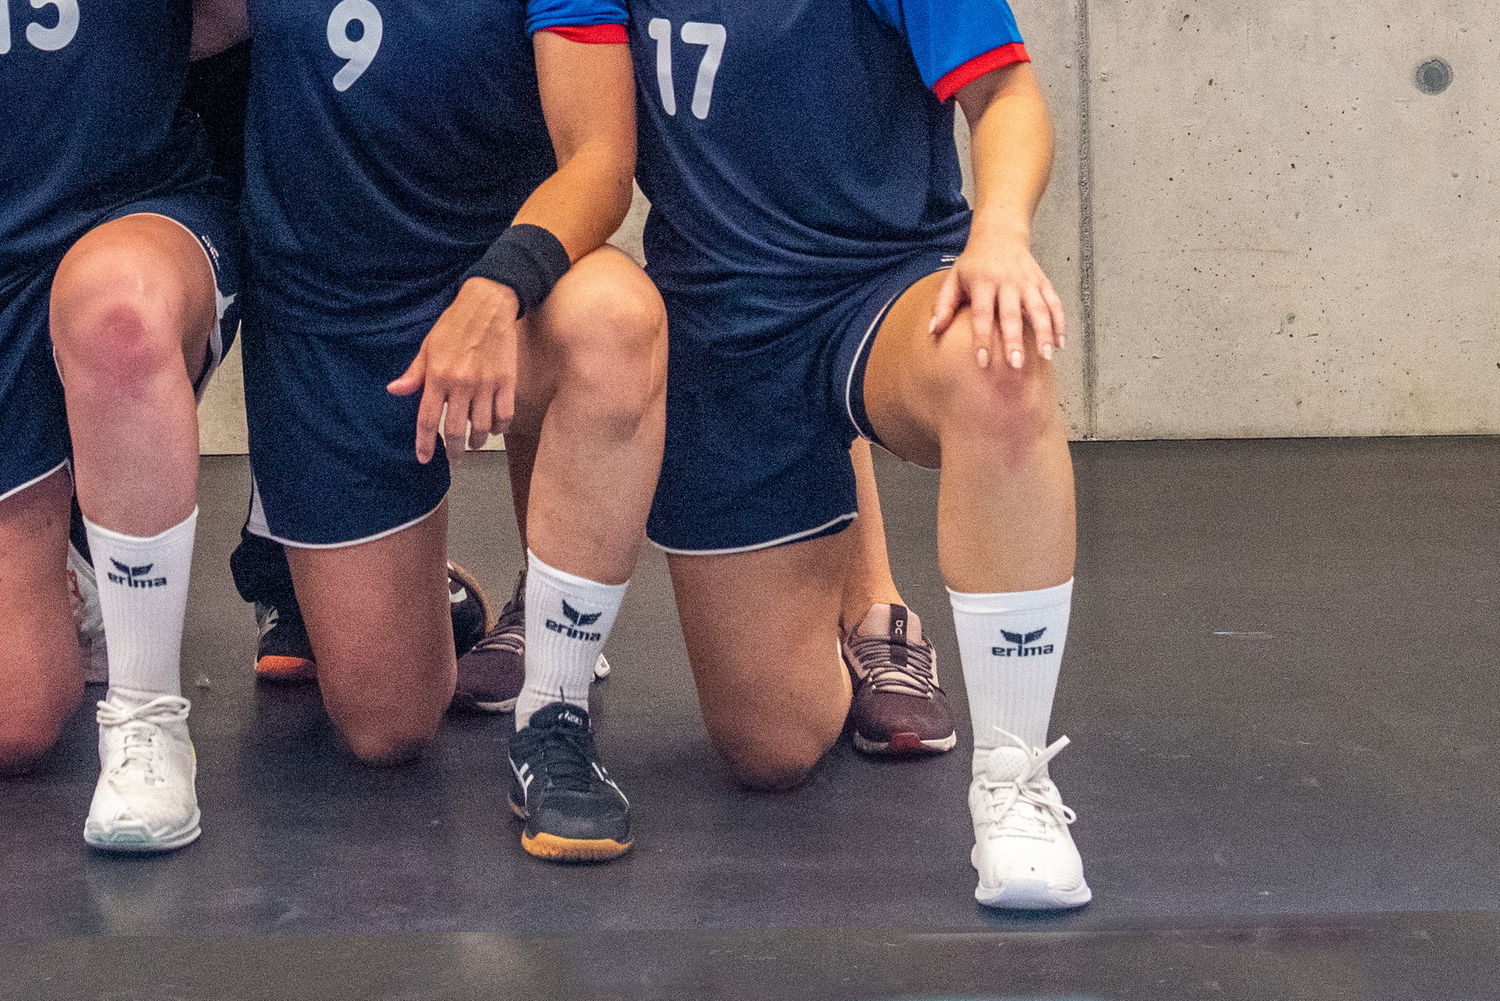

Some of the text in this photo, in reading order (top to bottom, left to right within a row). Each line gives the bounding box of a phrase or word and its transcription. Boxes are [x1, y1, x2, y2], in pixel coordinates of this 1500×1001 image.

[648, 17, 727, 120] 17
[108, 572, 167, 588] erima
[546, 619, 601, 641] erima
[992, 644, 1054, 657] erima
